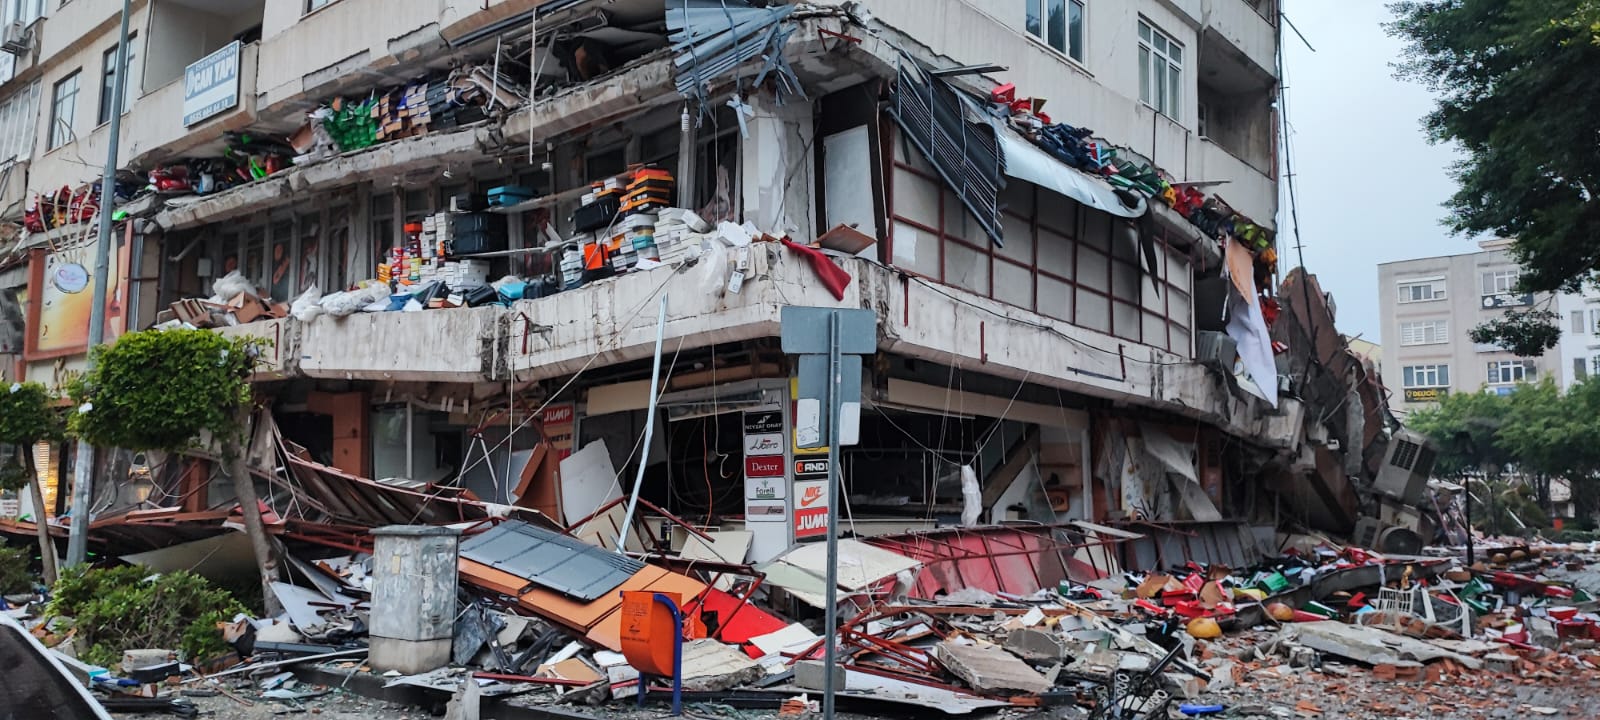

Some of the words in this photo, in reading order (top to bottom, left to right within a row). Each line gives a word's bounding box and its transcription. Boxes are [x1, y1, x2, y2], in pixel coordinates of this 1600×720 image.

[544, 409, 570, 421] JUMP
[752, 462, 779, 472] Dexter
[805, 486, 822, 497] NIKE
